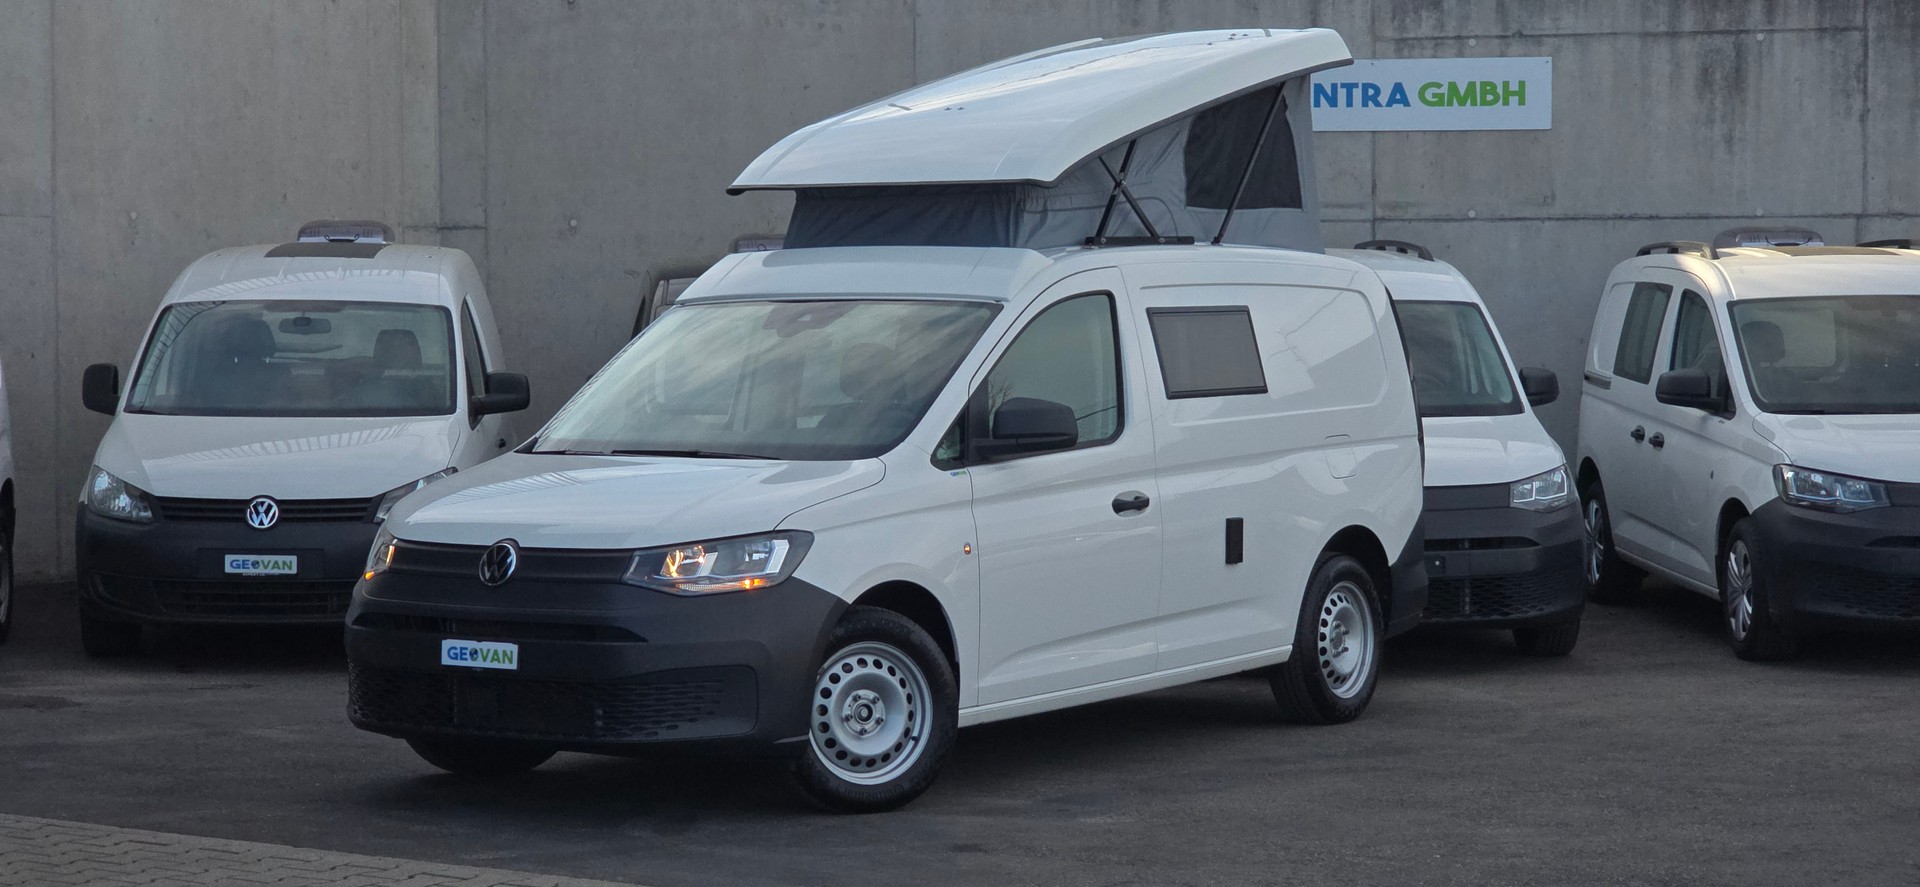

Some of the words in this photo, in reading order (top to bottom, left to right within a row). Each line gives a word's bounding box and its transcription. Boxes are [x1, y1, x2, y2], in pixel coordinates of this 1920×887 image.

[1417, 80, 1526, 107] GMBH
[229, 559, 293, 571] GEOVAN
[447, 646, 514, 665] GEOVAN
